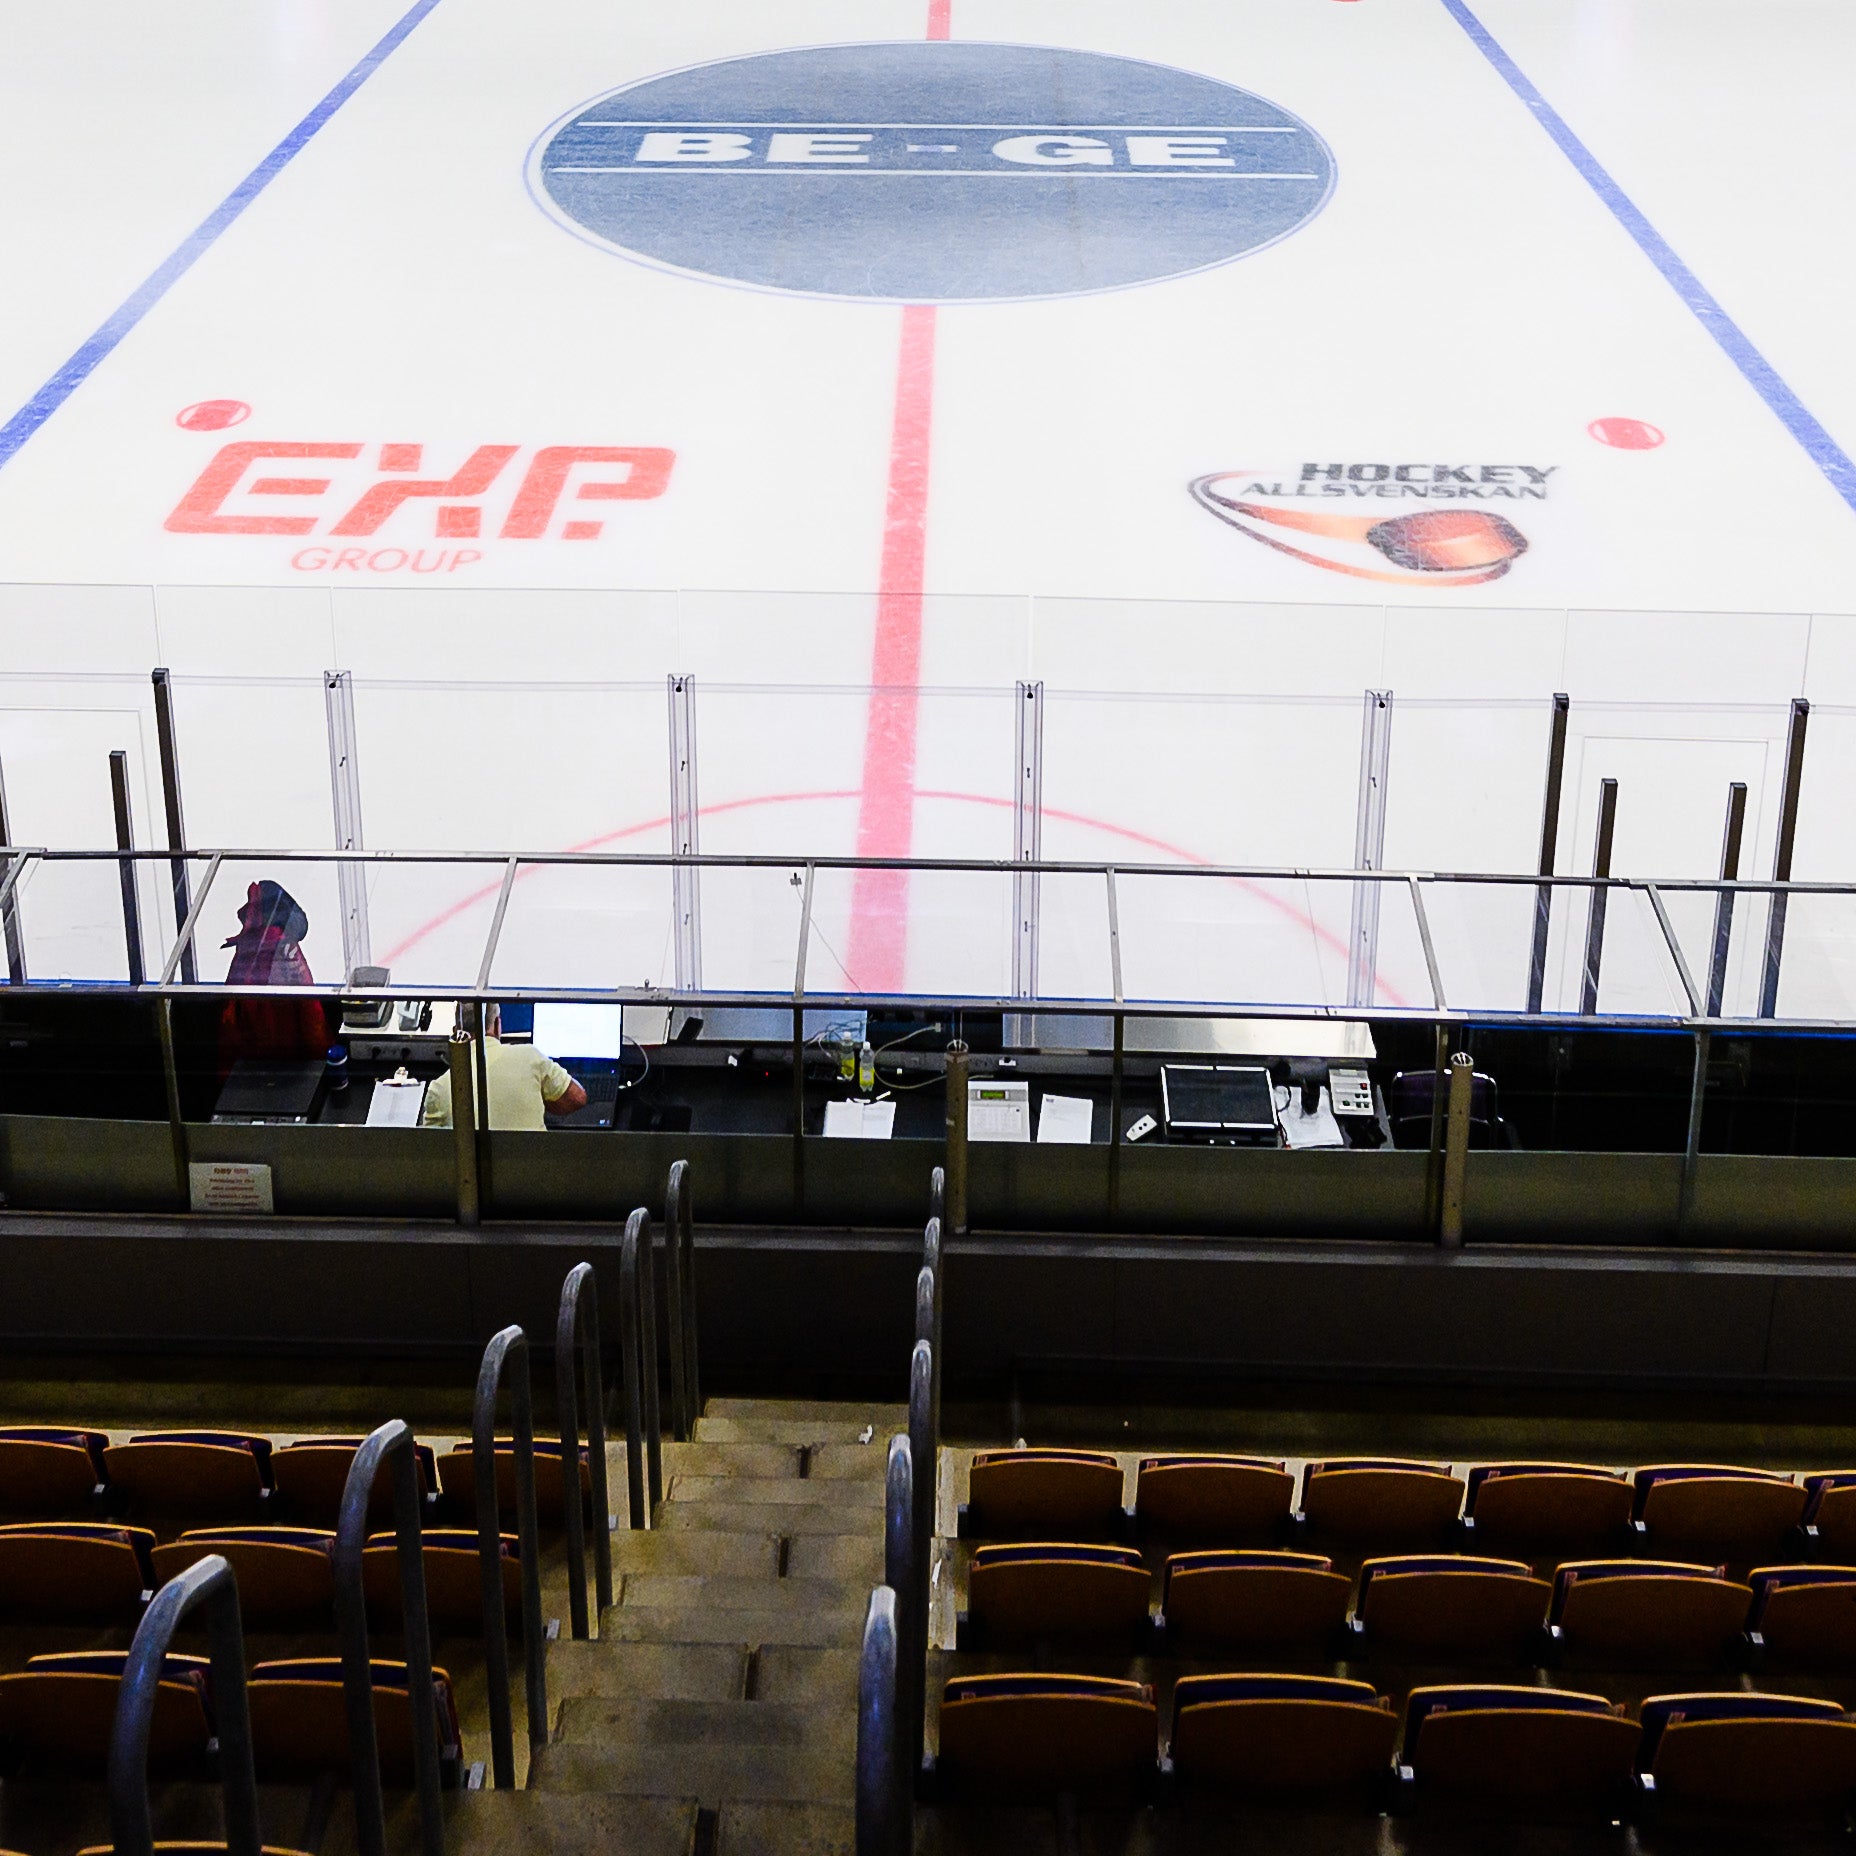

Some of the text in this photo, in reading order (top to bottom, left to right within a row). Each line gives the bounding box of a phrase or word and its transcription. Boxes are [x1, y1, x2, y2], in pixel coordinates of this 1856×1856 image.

[1300, 462, 1561, 486] HOCKEY
[163, 440, 677, 540] EXP
[1239, 481, 1549, 500] ALLSVENSKAN
[291, 546, 485, 574] GROUP
